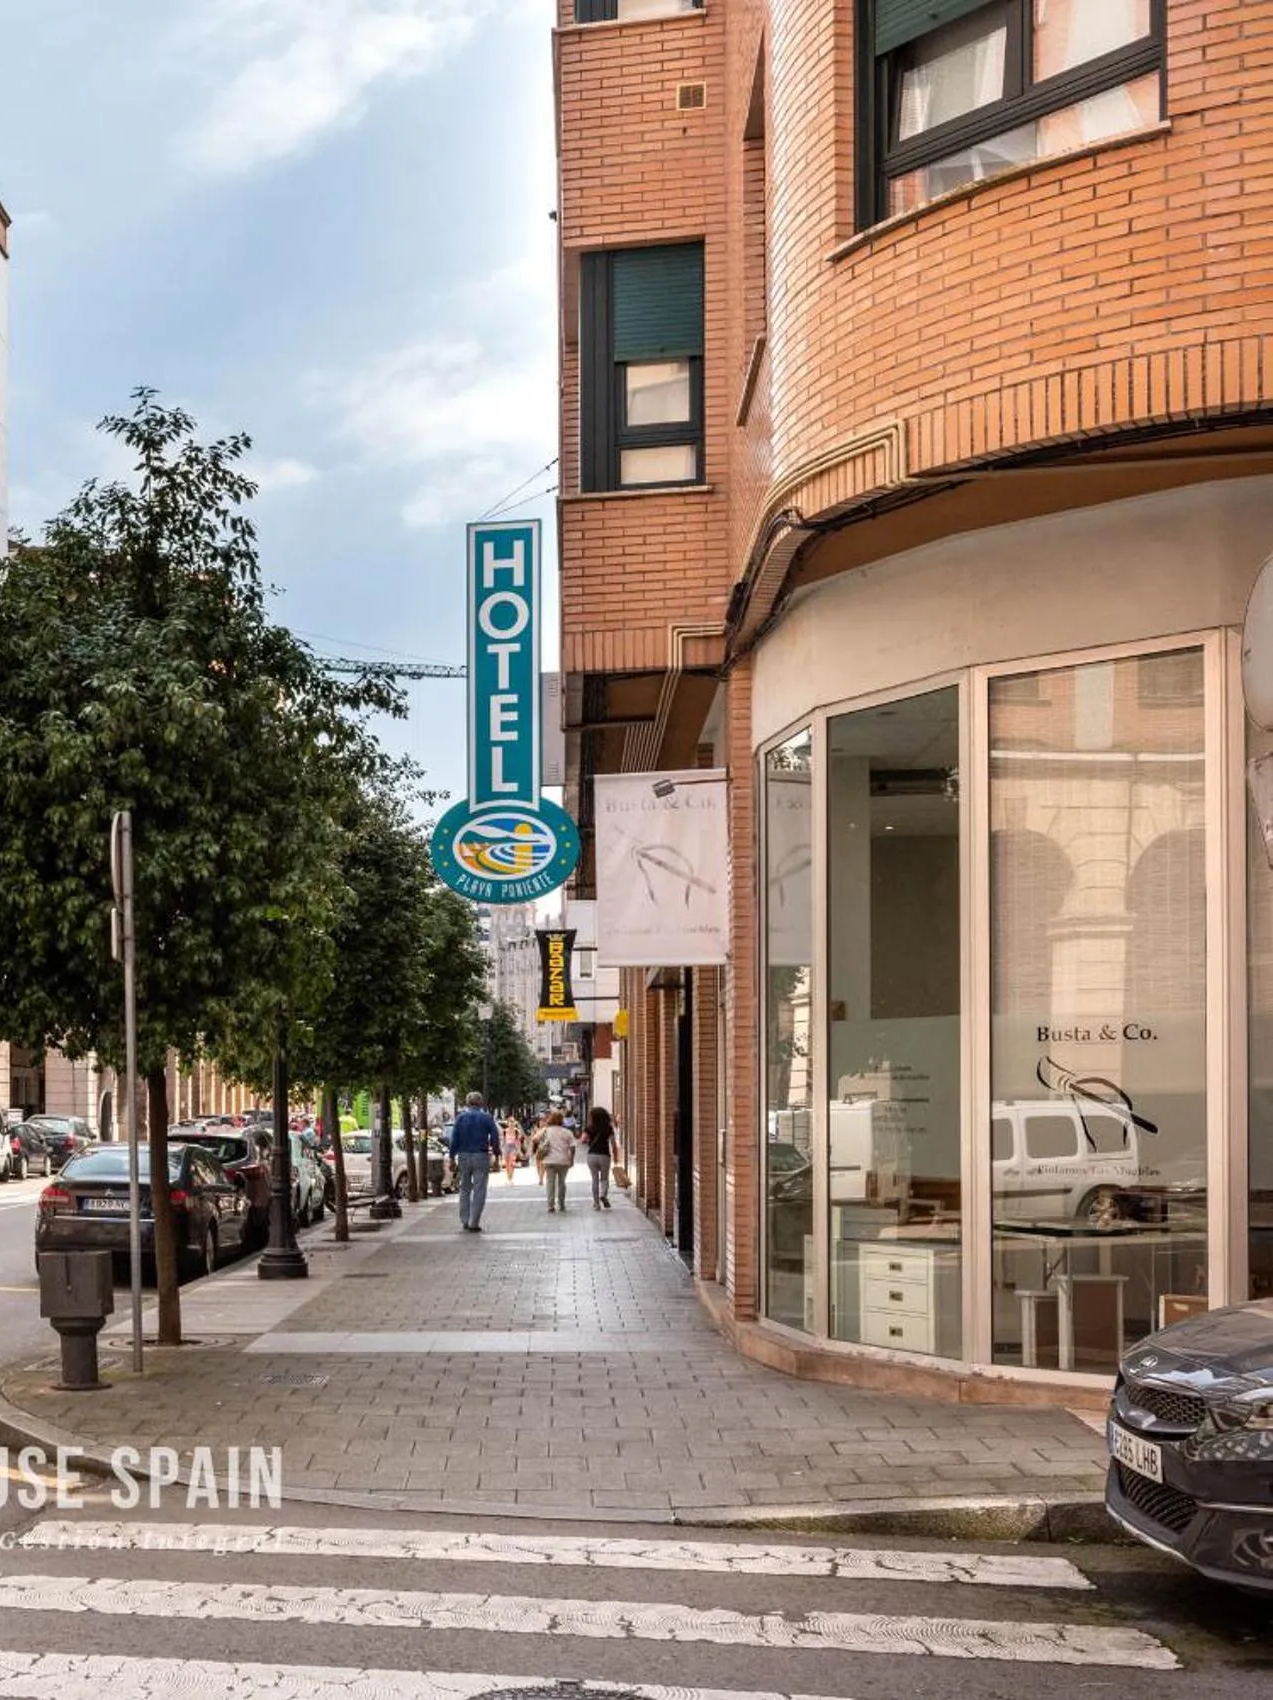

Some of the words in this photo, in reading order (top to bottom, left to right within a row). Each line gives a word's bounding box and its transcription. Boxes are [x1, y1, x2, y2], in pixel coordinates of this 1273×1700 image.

[479, 540, 529, 793] HOTEL
[456, 874, 493, 898] PLAYA
[501, 871, 555, 898] PONIENTE
[1037, 1026, 1091, 1042] Busta
[1098, 1025, 1117, 1041] &
[1122, 1023, 1159, 1041] Co.
[1136, 1441, 1158, 1475] LHB
